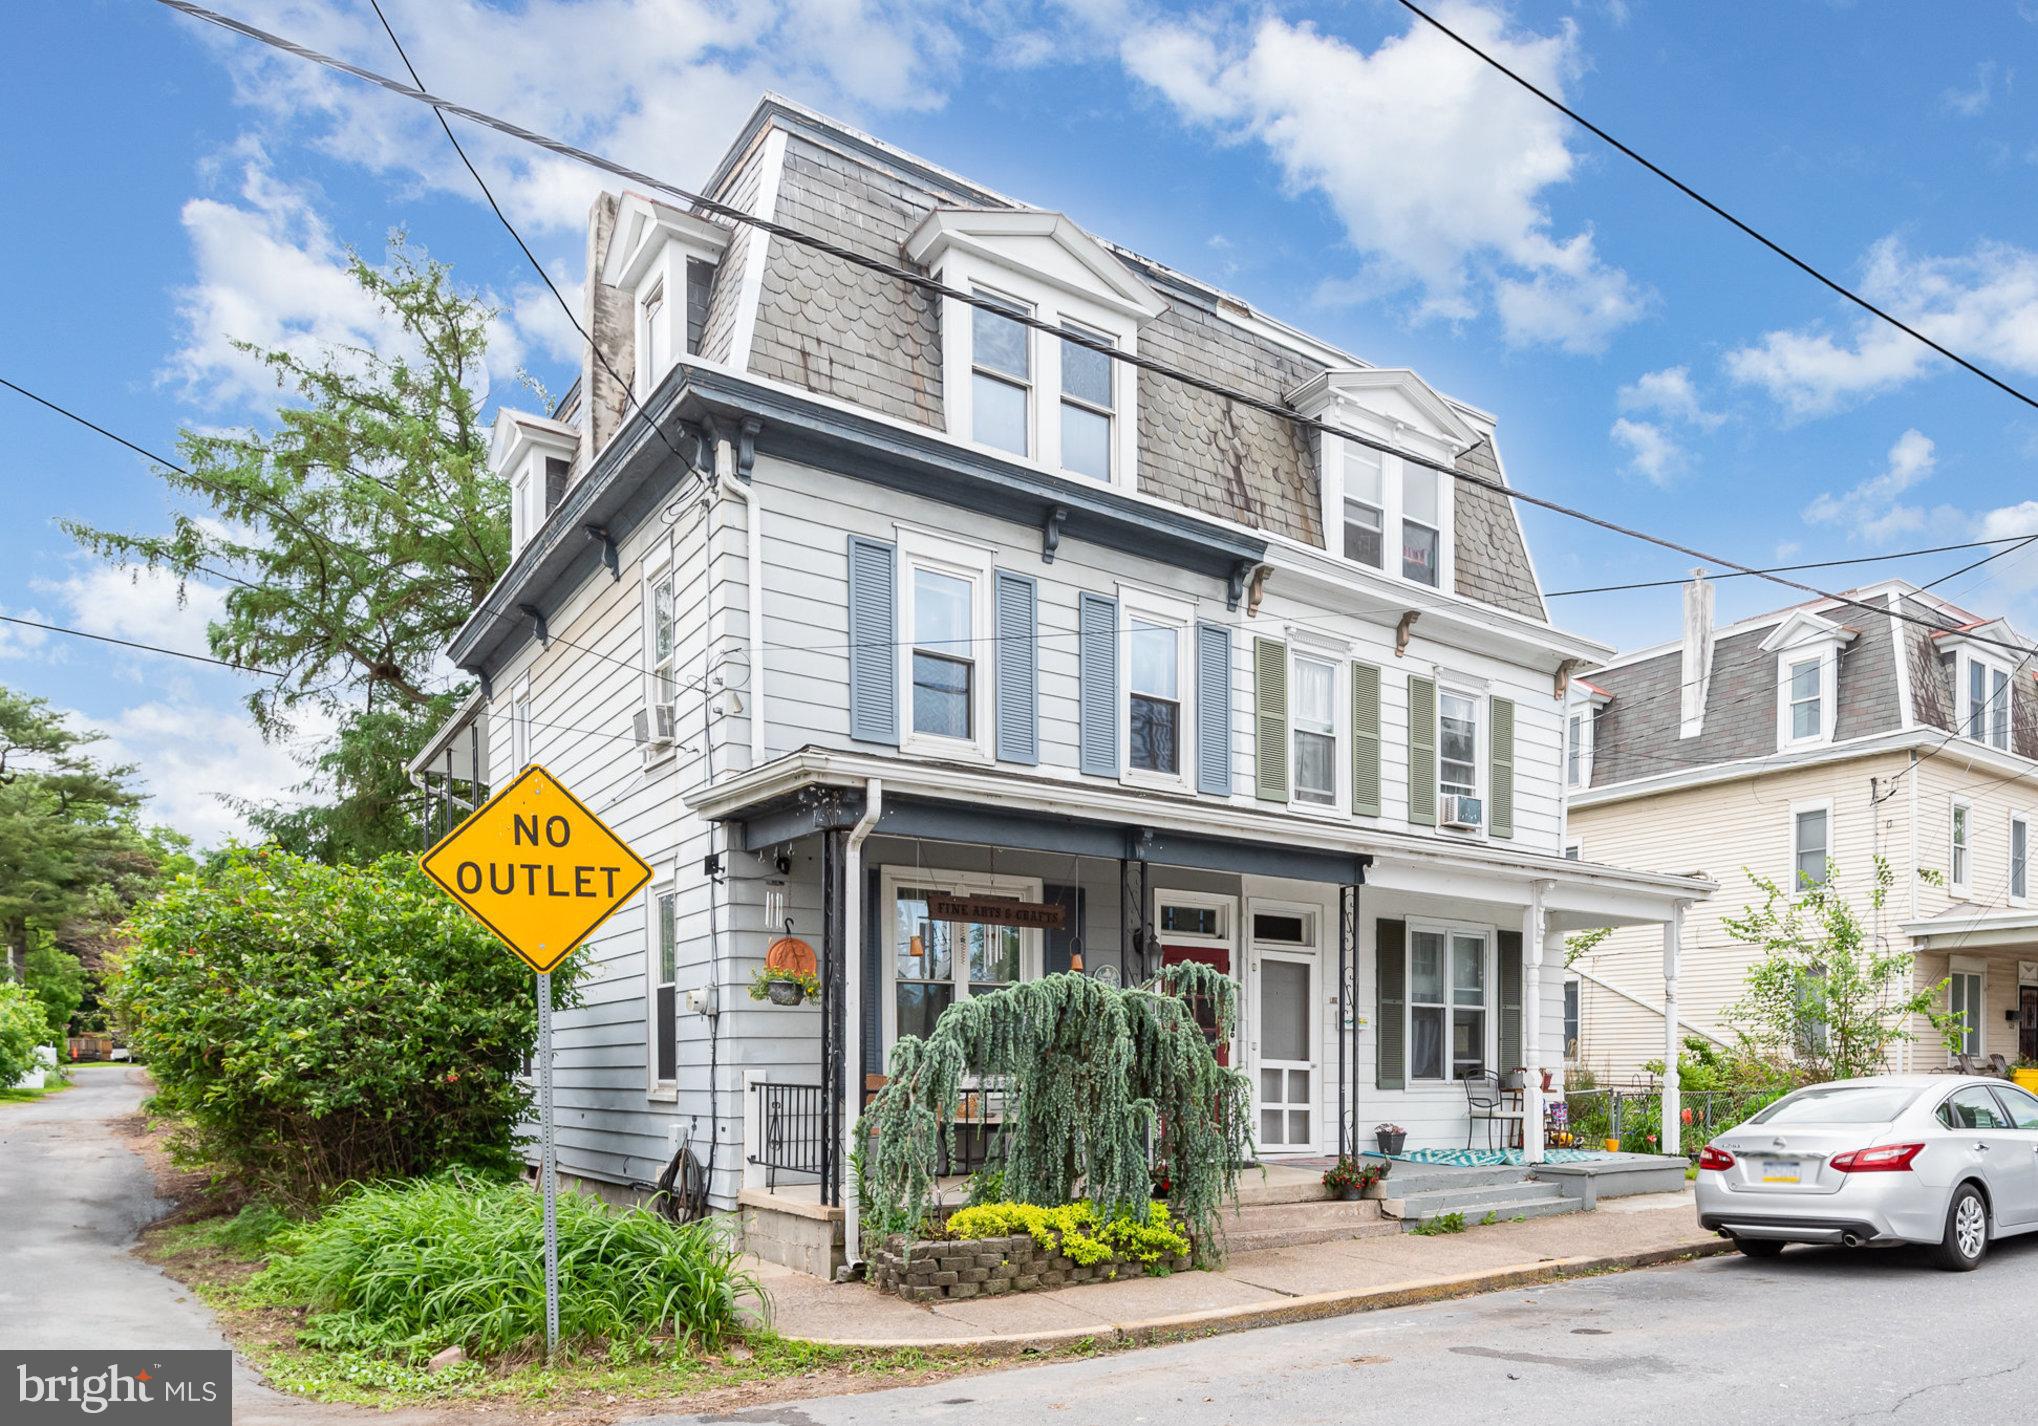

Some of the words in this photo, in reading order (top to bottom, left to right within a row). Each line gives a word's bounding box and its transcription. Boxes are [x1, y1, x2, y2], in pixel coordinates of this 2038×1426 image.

[513, 813, 571, 848] NO
[456, 861, 621, 898] OUTLET
[938, 902, 968, 916] FINE
[973, 905, 1000, 919] ARTS
[1016, 909, 1059, 923] CRAFTS
